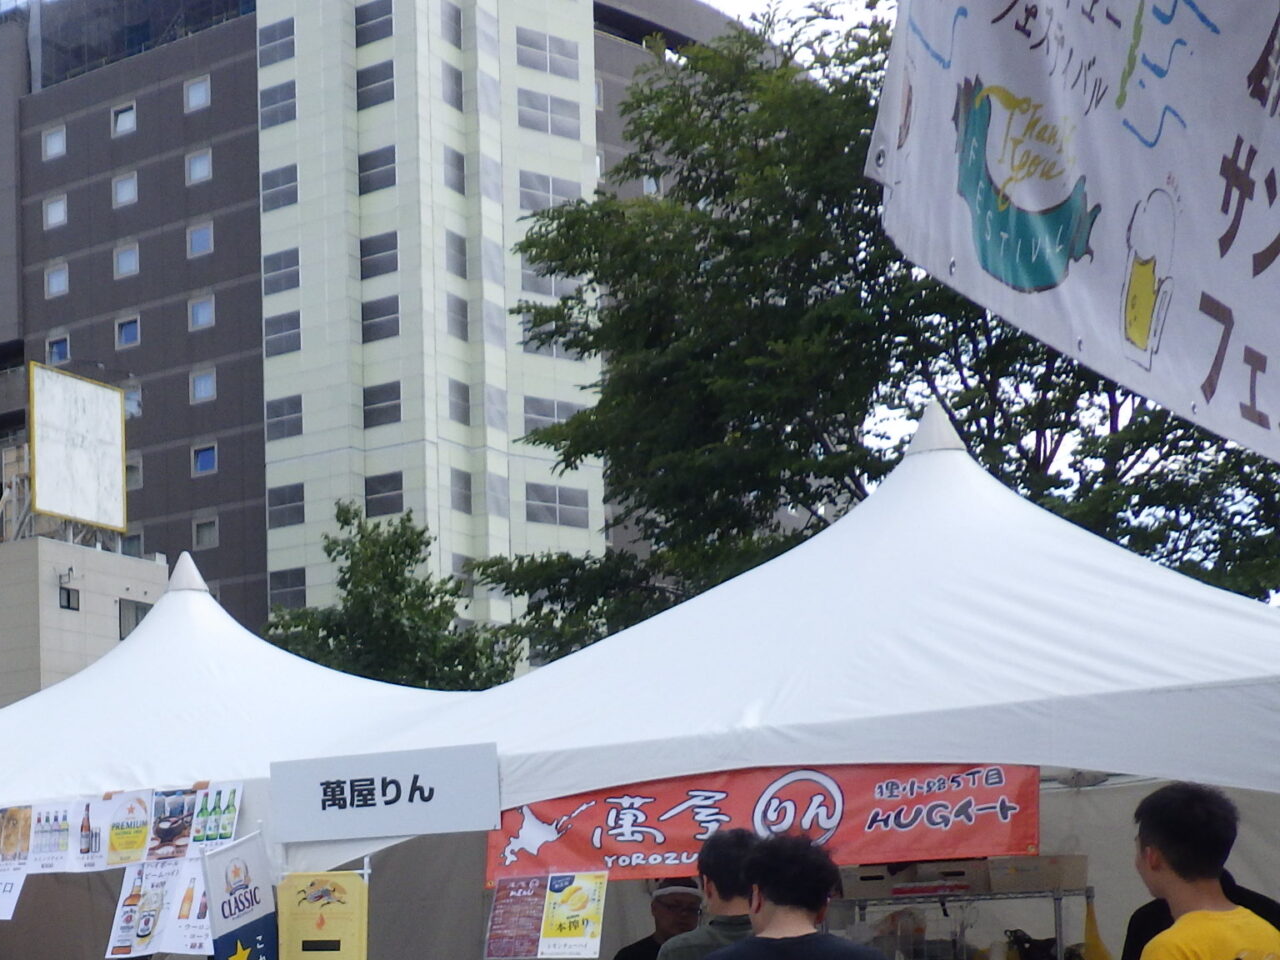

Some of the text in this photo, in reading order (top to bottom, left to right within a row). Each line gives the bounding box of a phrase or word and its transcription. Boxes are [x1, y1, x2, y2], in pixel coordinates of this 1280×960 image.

[320, 774, 435, 811] 萬屋りん
[111, 820, 148, 830] PREMIUM
[865, 796, 1019, 831] HUGイート
[221, 887, 261, 919] CLASSIC
